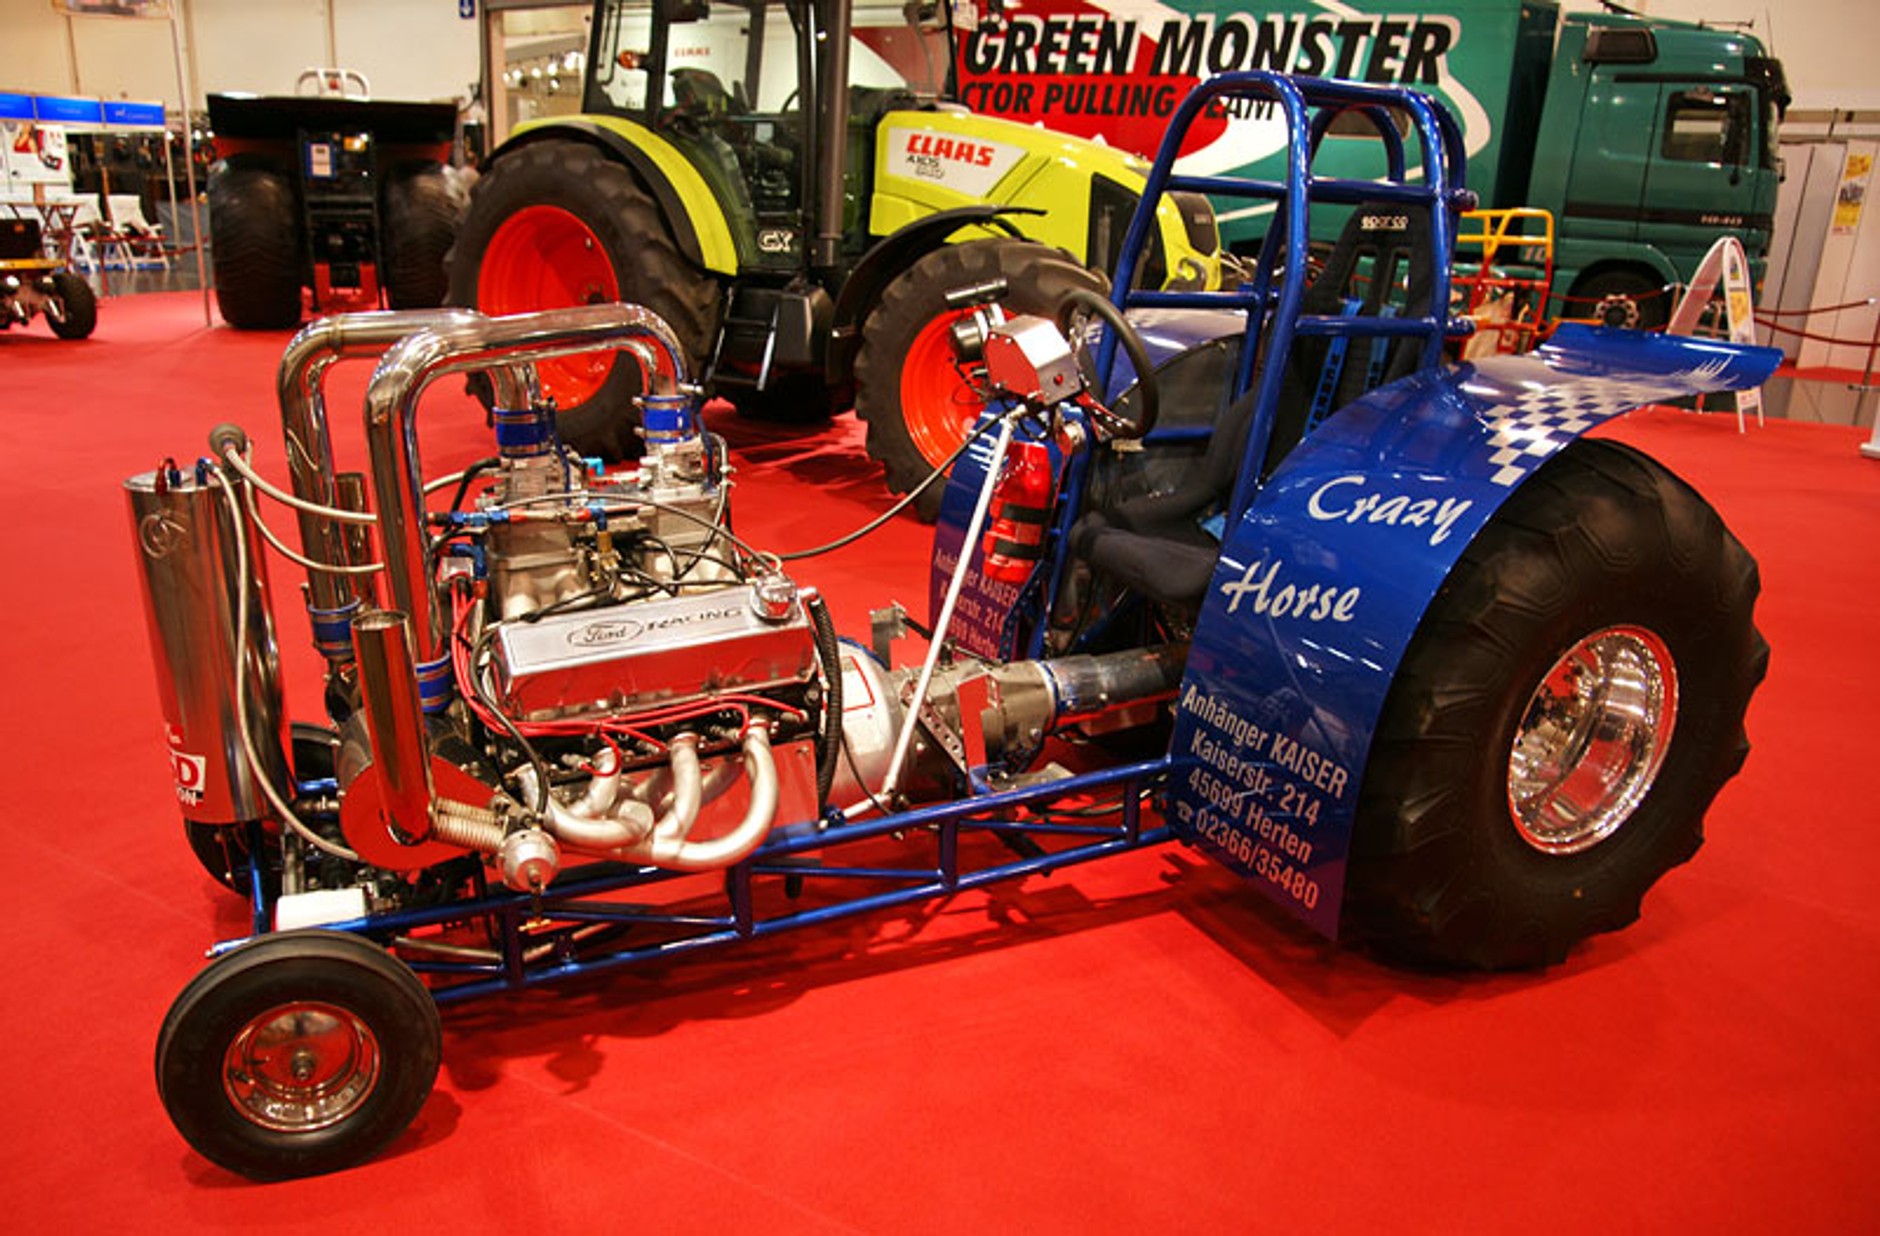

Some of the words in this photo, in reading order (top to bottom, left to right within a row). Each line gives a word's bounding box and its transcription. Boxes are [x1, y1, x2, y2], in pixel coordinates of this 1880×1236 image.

[964, 20, 1138, 76] GREEN
[1149, 20, 1452, 85] MONSTER
[961, 82, 1035, 113] CTOR
[1041, 84, 1176, 118] PULLING
[1204, 94, 1275, 120] EAM
[906, 134, 995, 167] CLAAS
[1308, 475, 1473, 546] Crazy
[1220, 559, 1360, 622] Horse
[583, 622, 628, 643] Ford
[648, 608, 743, 632] RACING
[1182, 684, 1269, 751] Anhänger
[1269, 732, 1348, 799] KAISER
[1191, 728, 1274, 801] Kaiserstr.
[1279, 783, 1321, 827] 214
[1188, 767, 1244, 818] 45699
[1245, 802, 1313, 865] Herten
[1196, 808, 1320, 911] 02366/35480
